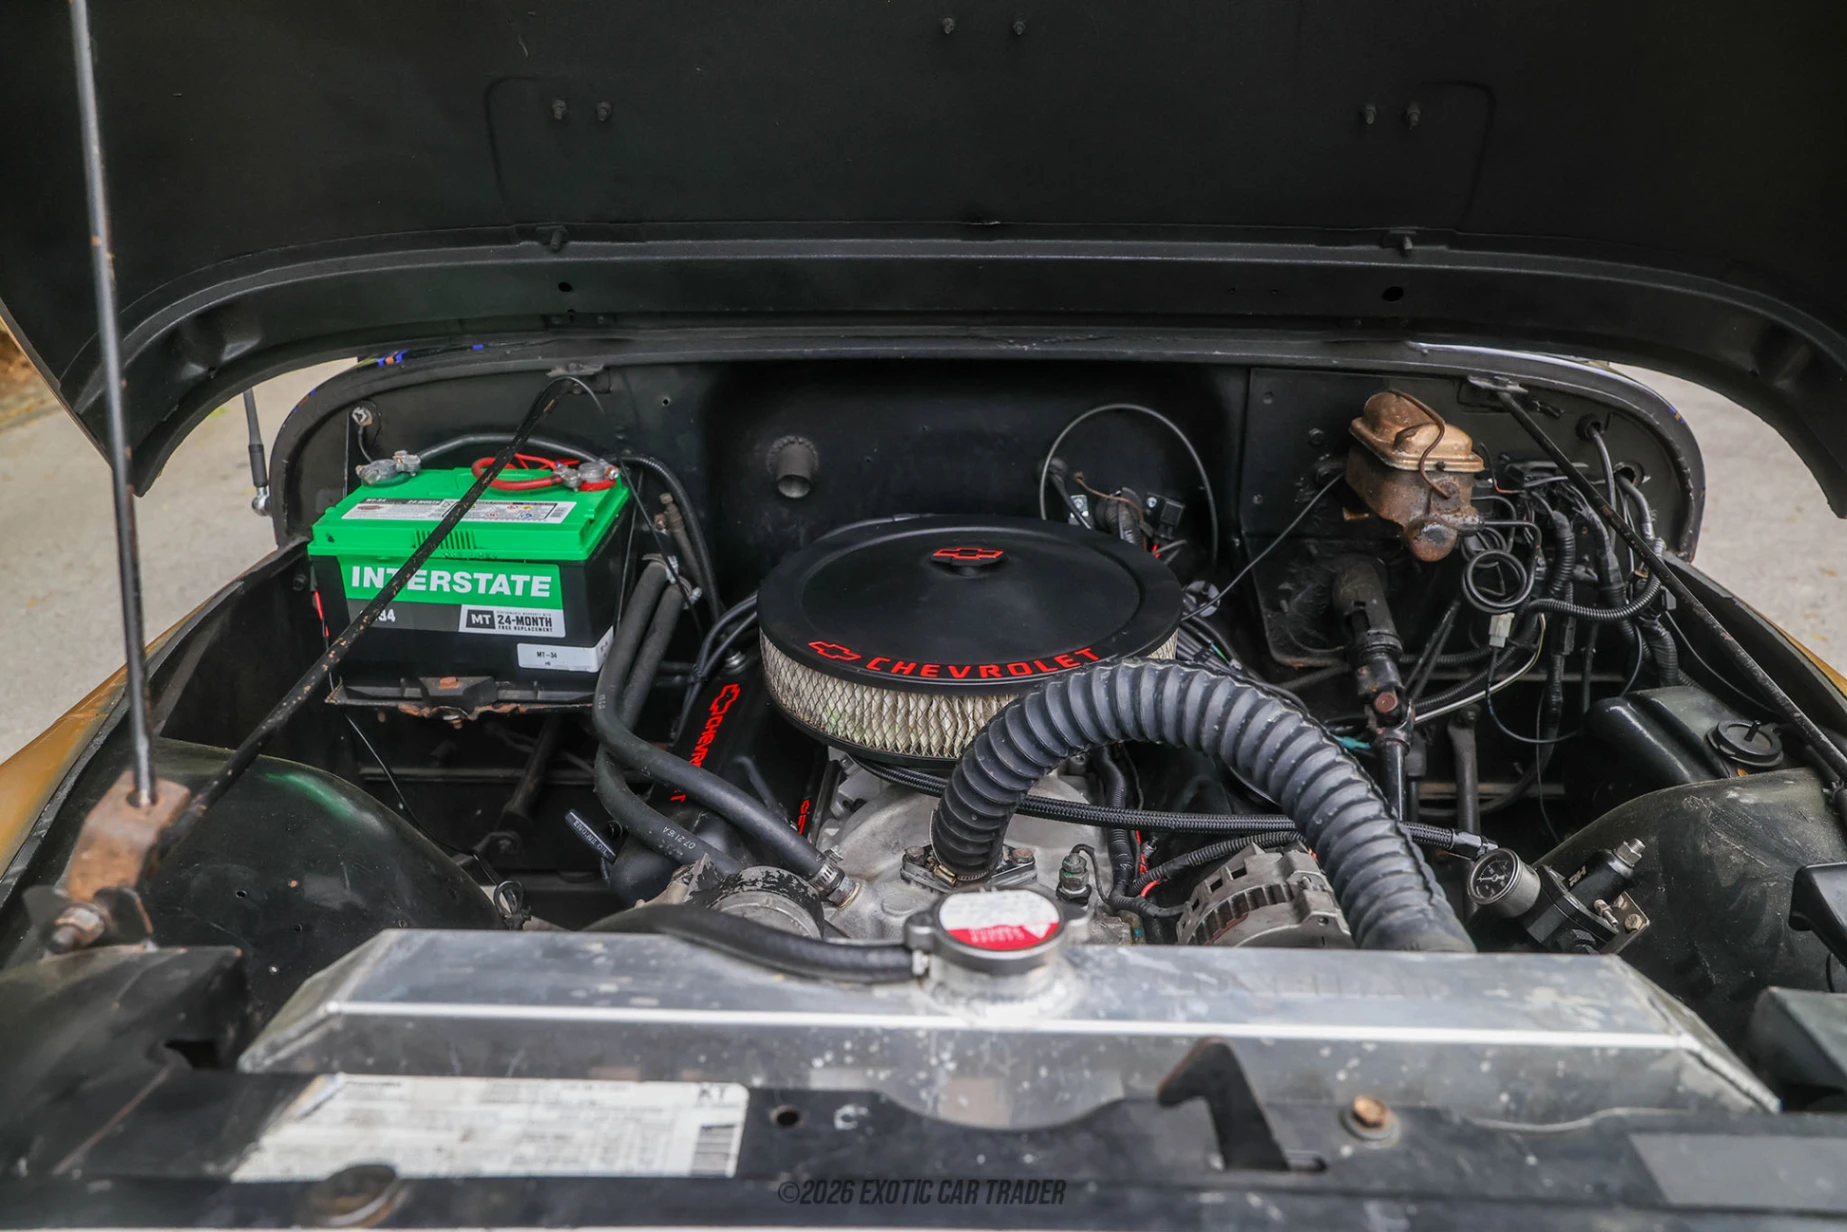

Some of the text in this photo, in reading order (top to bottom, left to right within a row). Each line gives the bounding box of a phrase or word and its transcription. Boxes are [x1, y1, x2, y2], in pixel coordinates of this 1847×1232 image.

[471, 613, 491, 625] MT
[497, 614, 553, 627] 24-MONTH
[865, 647, 1100, 680] CHEVROLET
